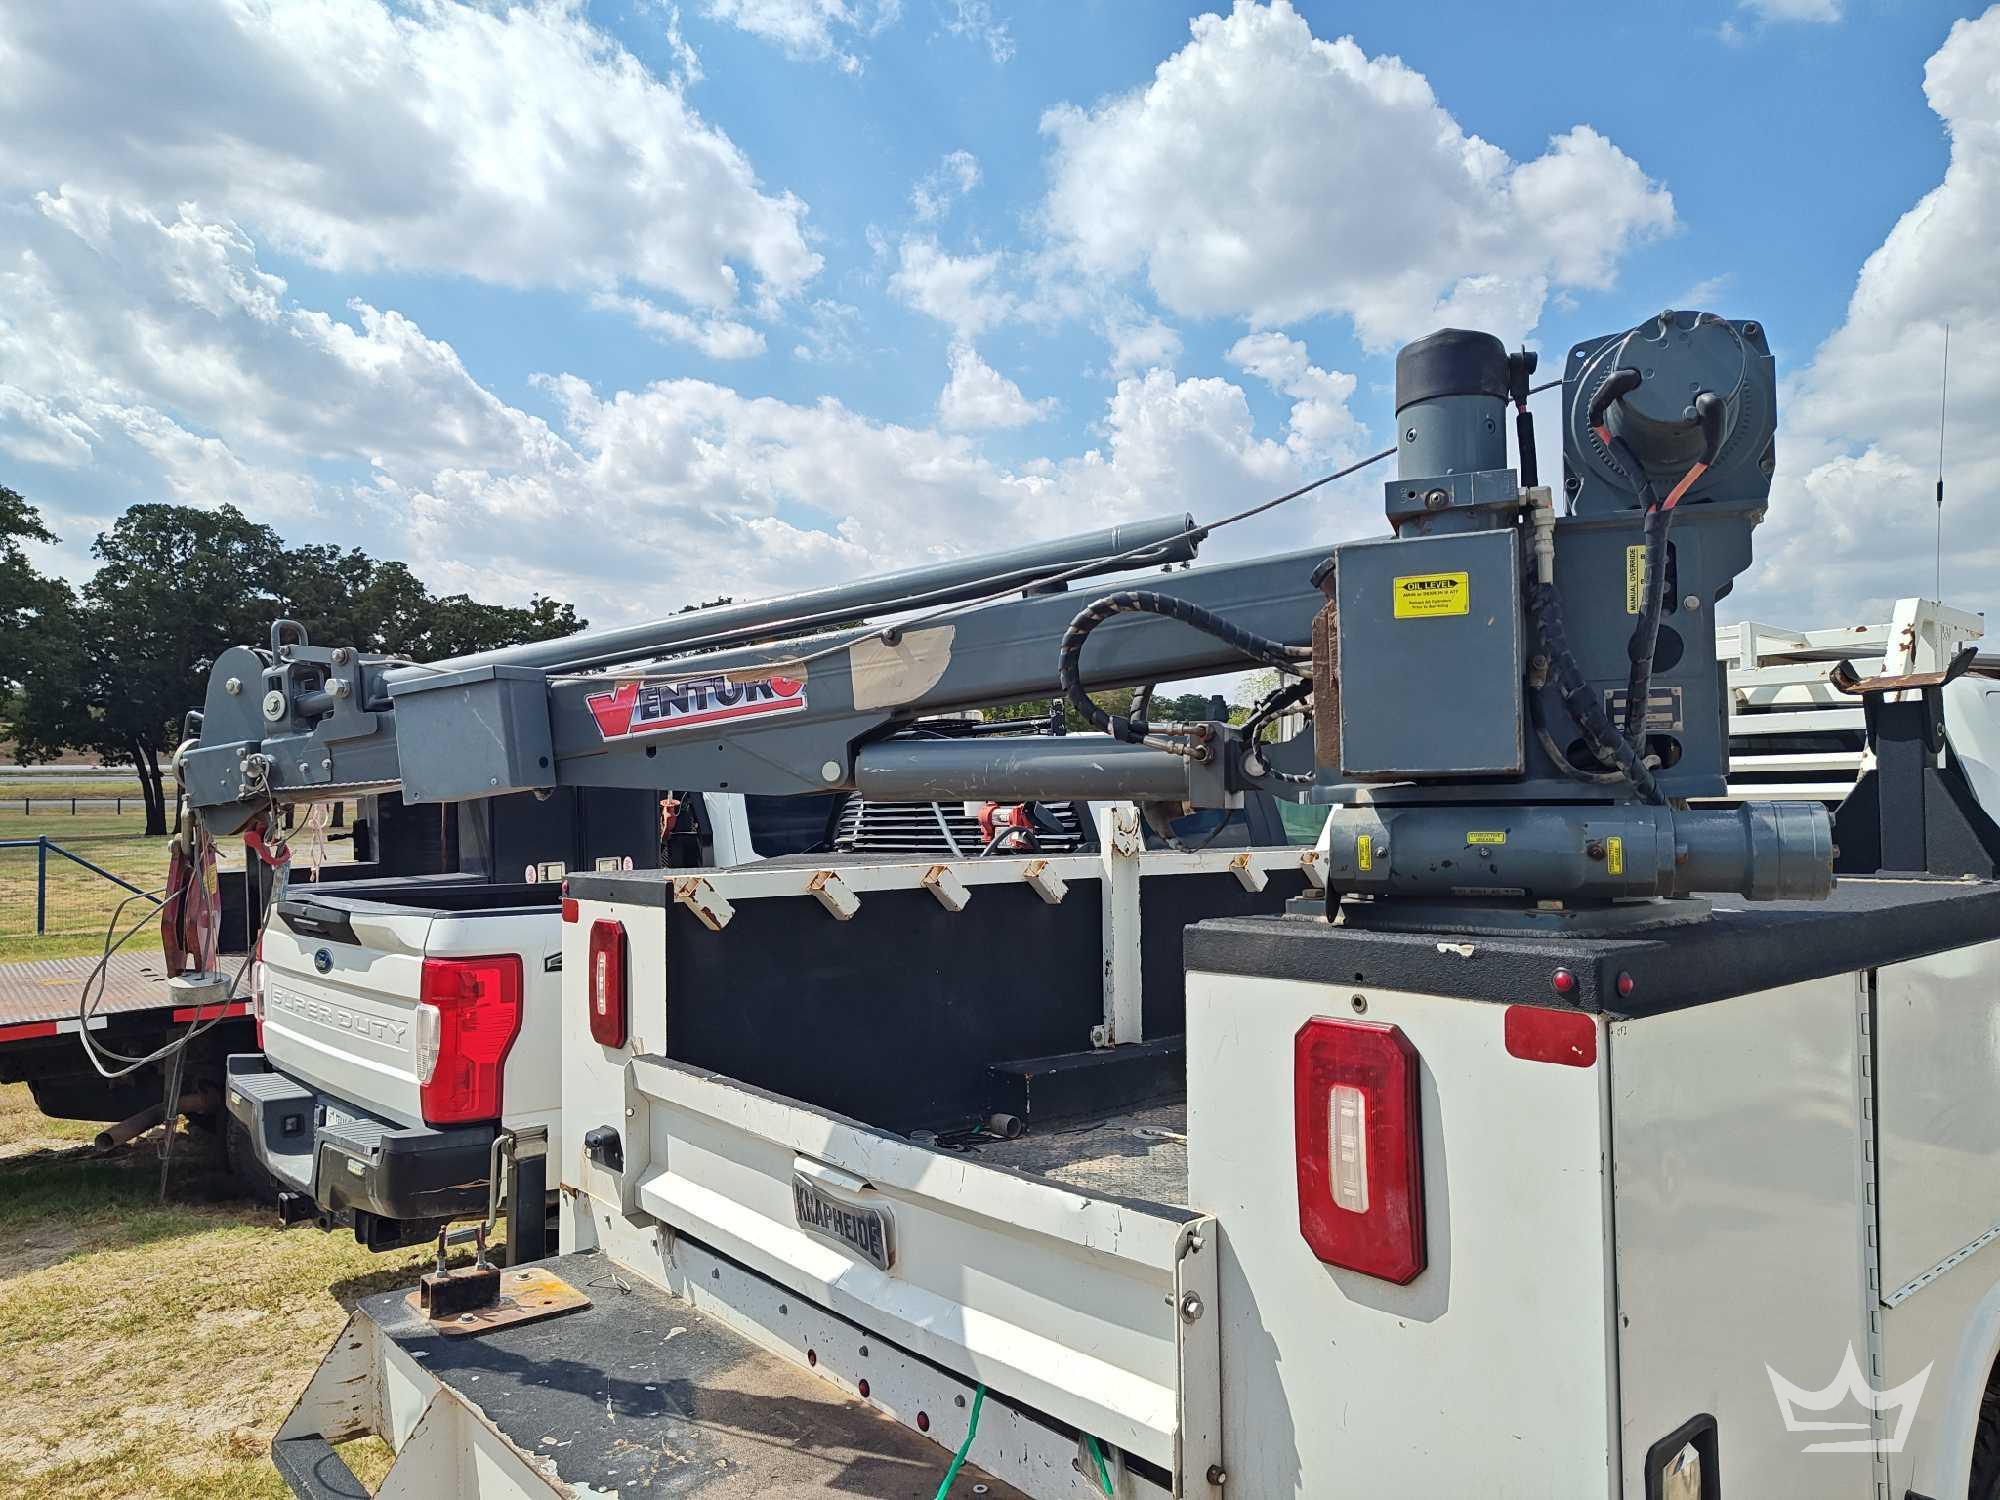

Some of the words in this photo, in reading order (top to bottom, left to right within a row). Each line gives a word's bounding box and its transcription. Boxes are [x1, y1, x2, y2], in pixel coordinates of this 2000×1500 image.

[1629, 547, 1637, 582] OVERRIDE
[1407, 583, 1423, 591] OIL
[1424, 580, 1453, 589] LEVEL
[1629, 583, 1637, 611] MANUAL
[270, 987, 333, 1024] SUPER
[337, 1010, 408, 1044] DUTY
[795, 1182, 882, 1262] KNAPHEIDE
